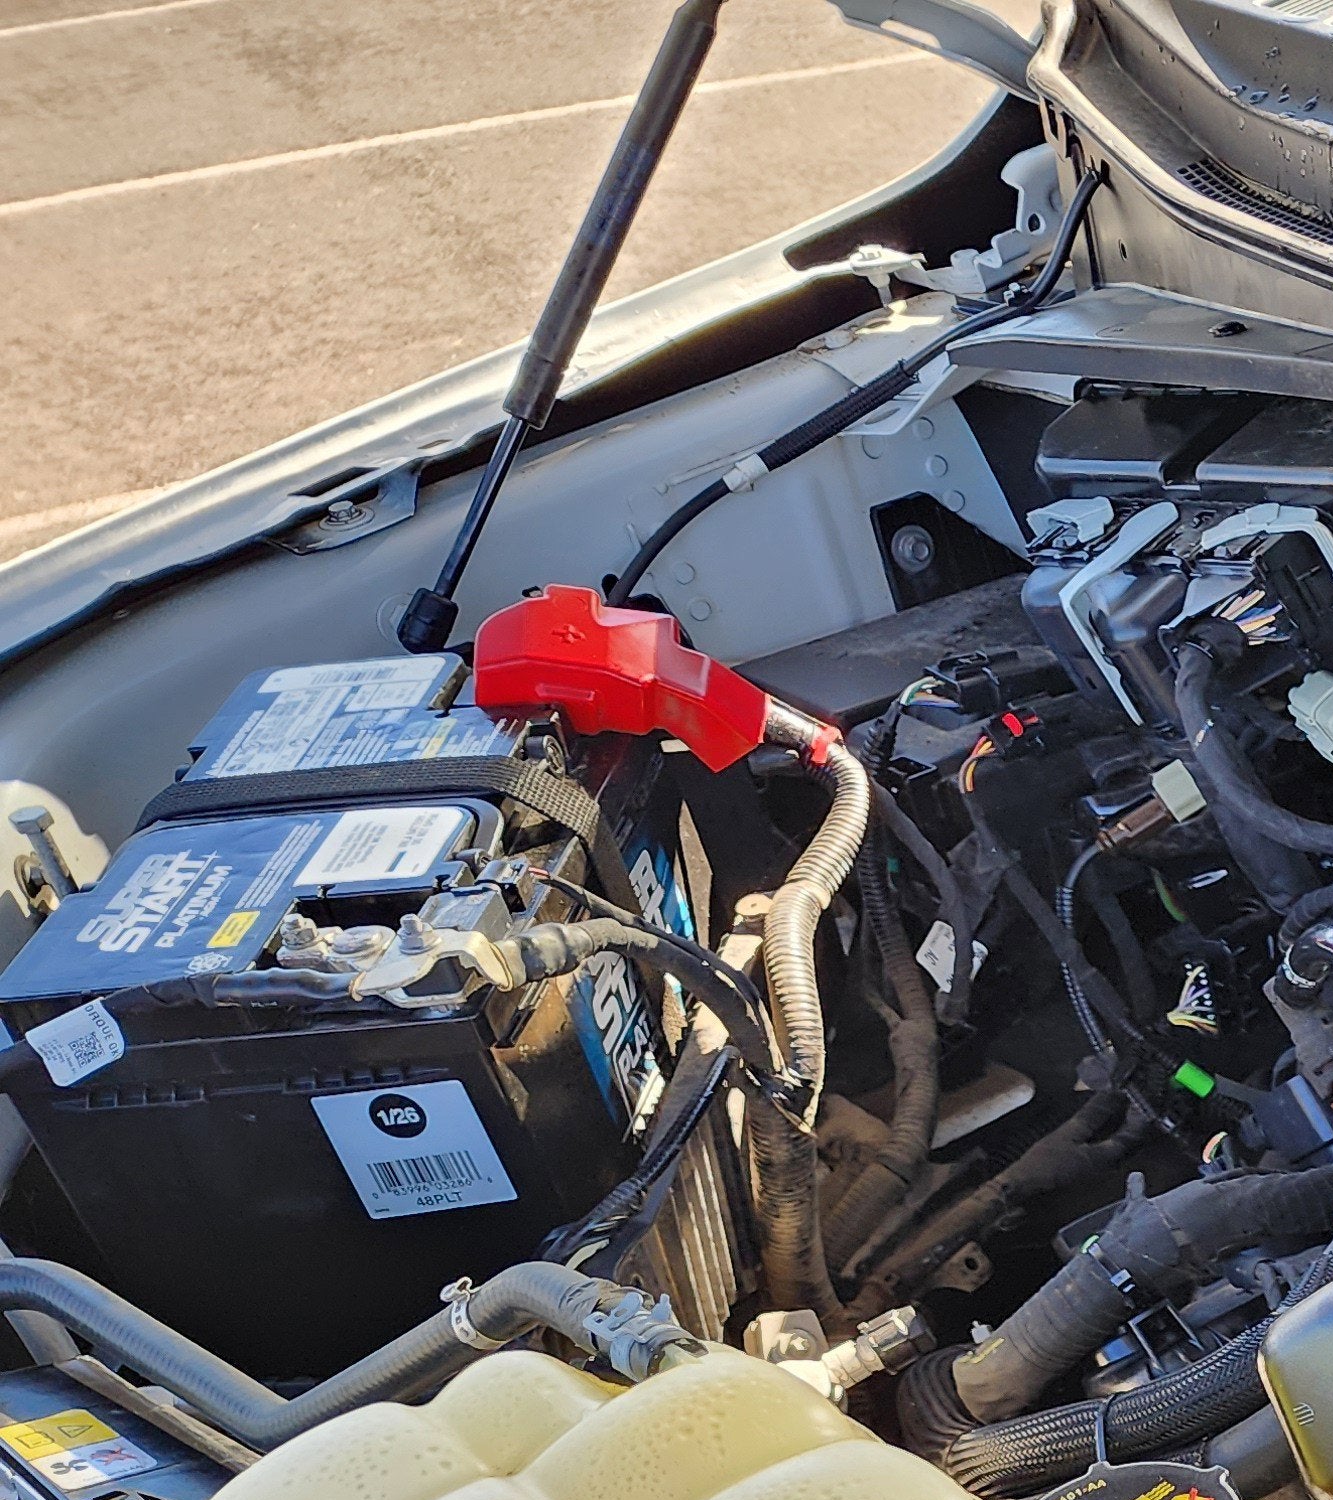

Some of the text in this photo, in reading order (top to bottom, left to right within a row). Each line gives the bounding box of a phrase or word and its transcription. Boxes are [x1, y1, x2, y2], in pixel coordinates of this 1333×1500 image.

[76, 853, 178, 942] SUPER
[98, 849, 207, 953] START
[153, 865, 233, 949] PLATINUM
[84, 1004, 115, 1041] ORQUE
[376, 1106, 421, 1127] 1/26
[416, 1191, 463, 1207] 48PLT
